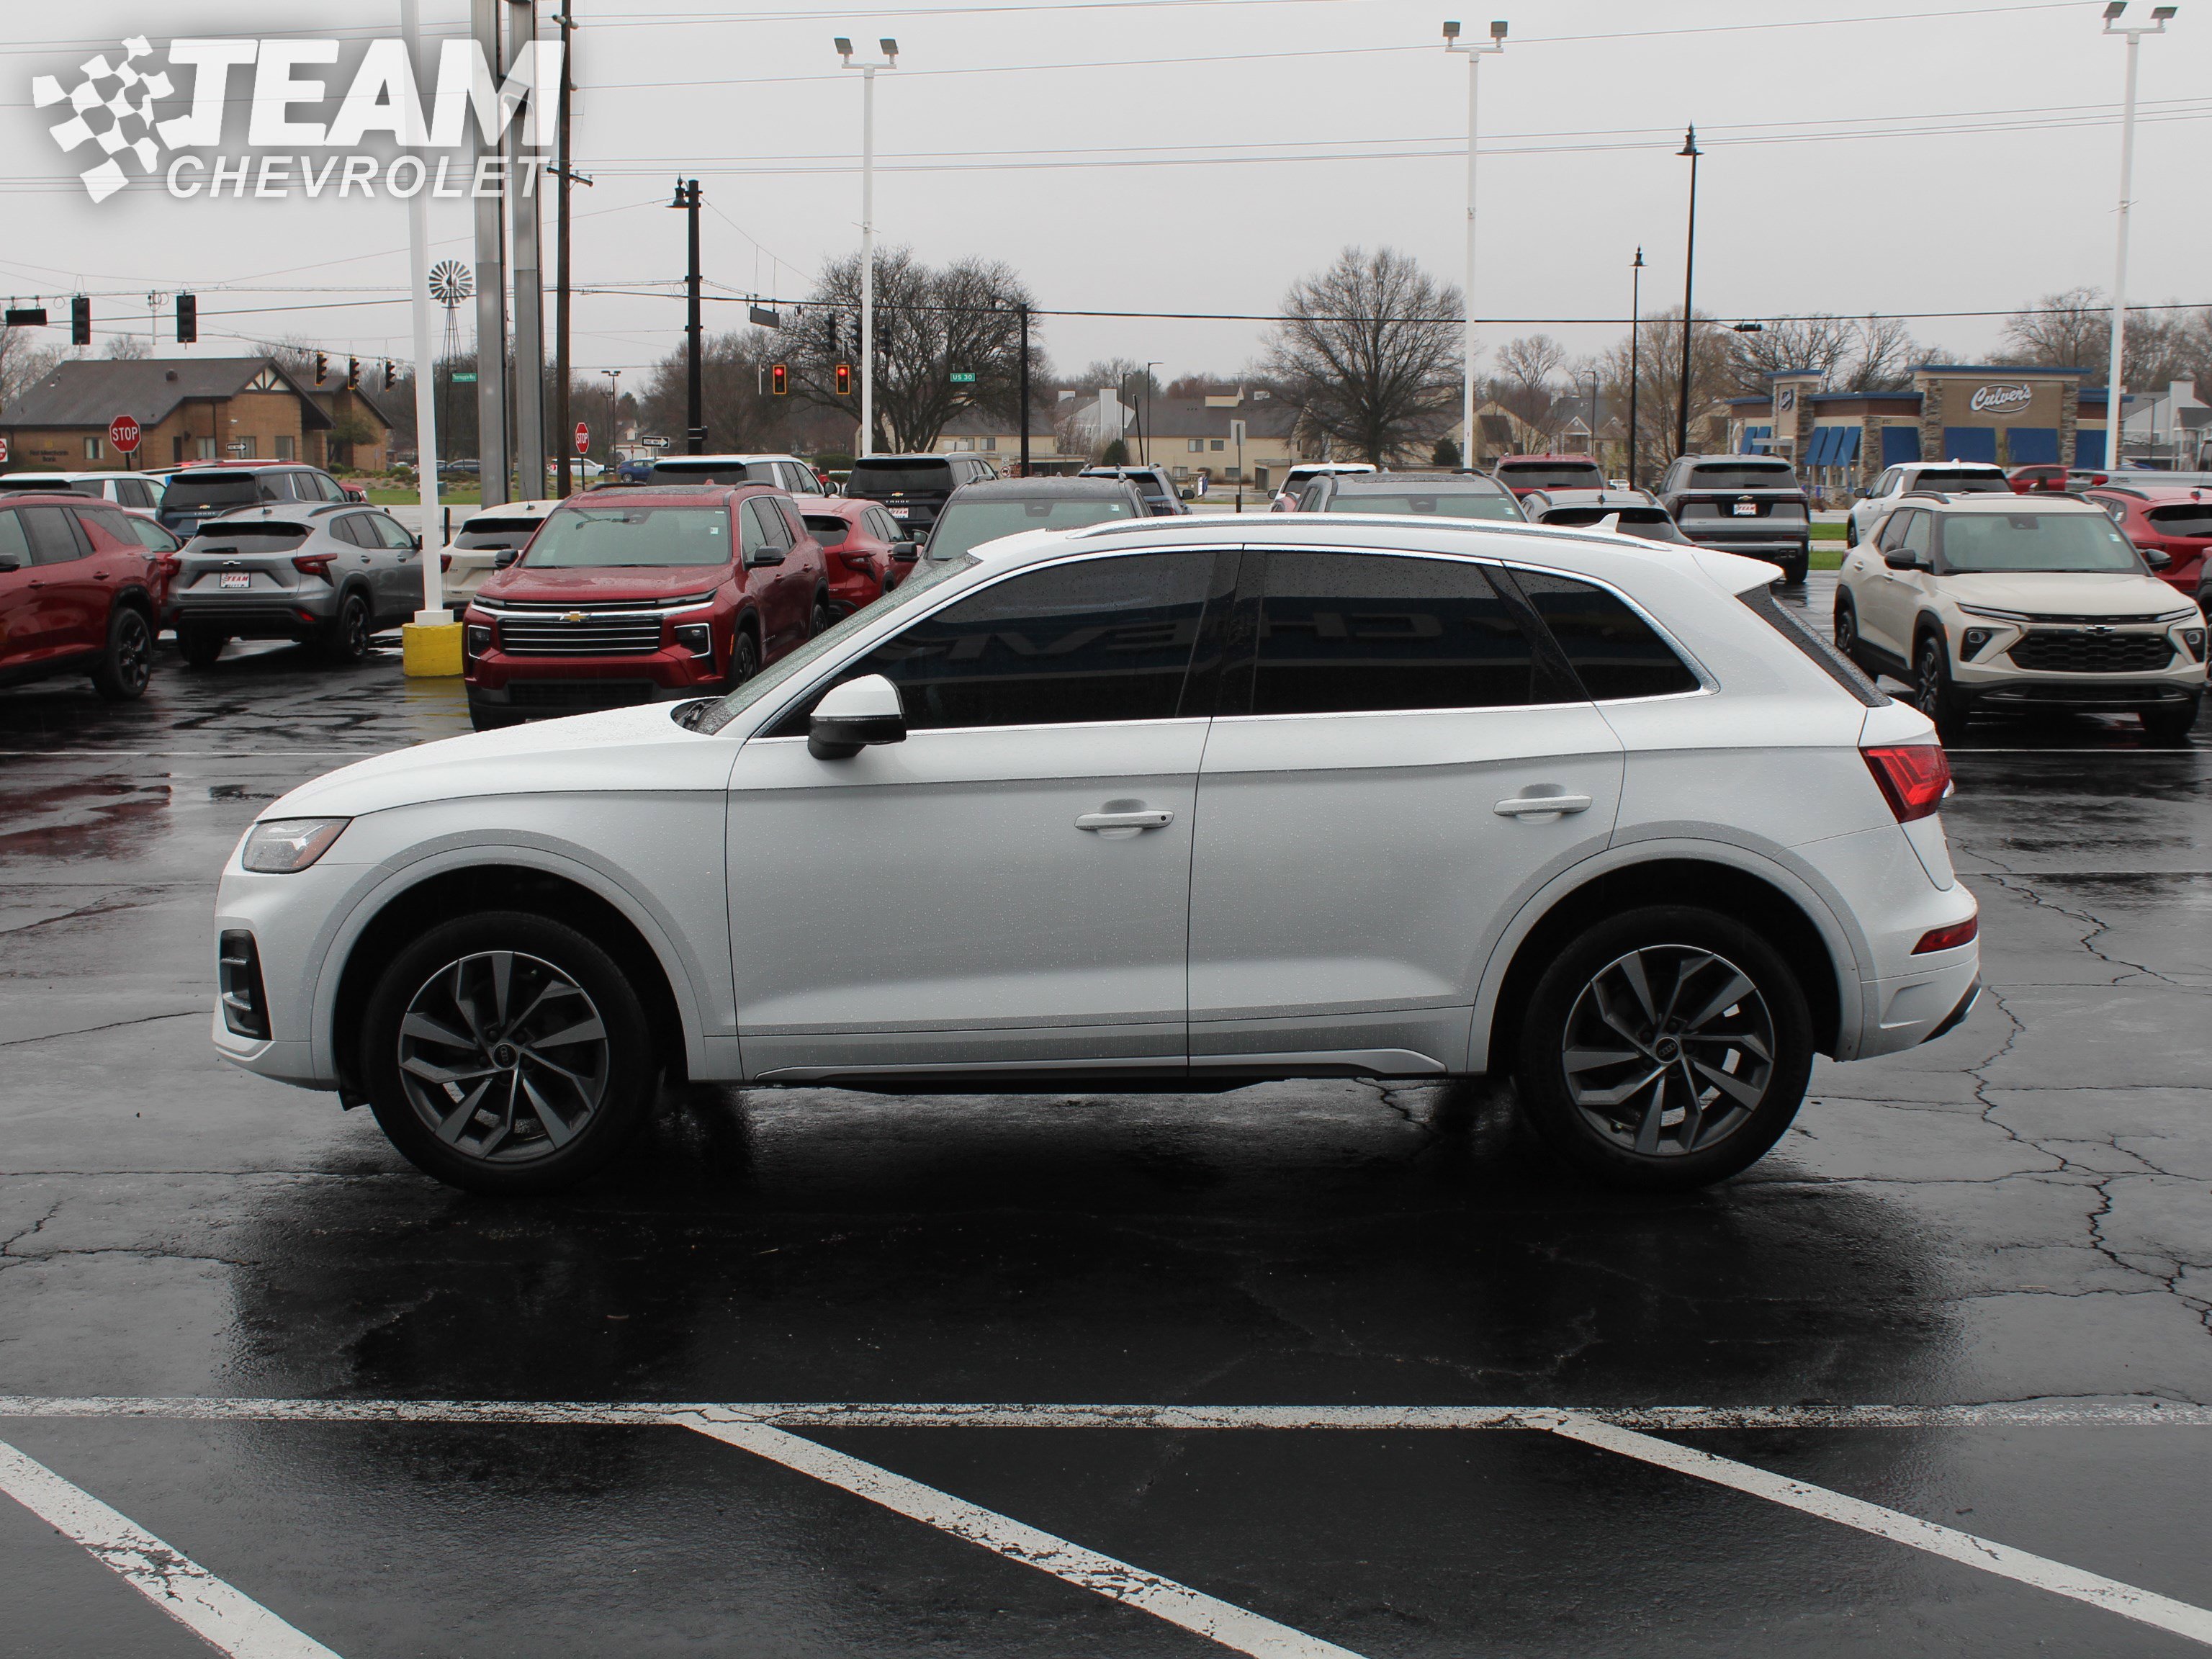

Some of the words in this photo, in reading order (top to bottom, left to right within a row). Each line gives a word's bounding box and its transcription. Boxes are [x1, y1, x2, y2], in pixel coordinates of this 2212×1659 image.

[1969, 384, 2033, 411] Culver's
[112, 427, 138, 441] STOP
[577, 433, 588, 444] STOP
